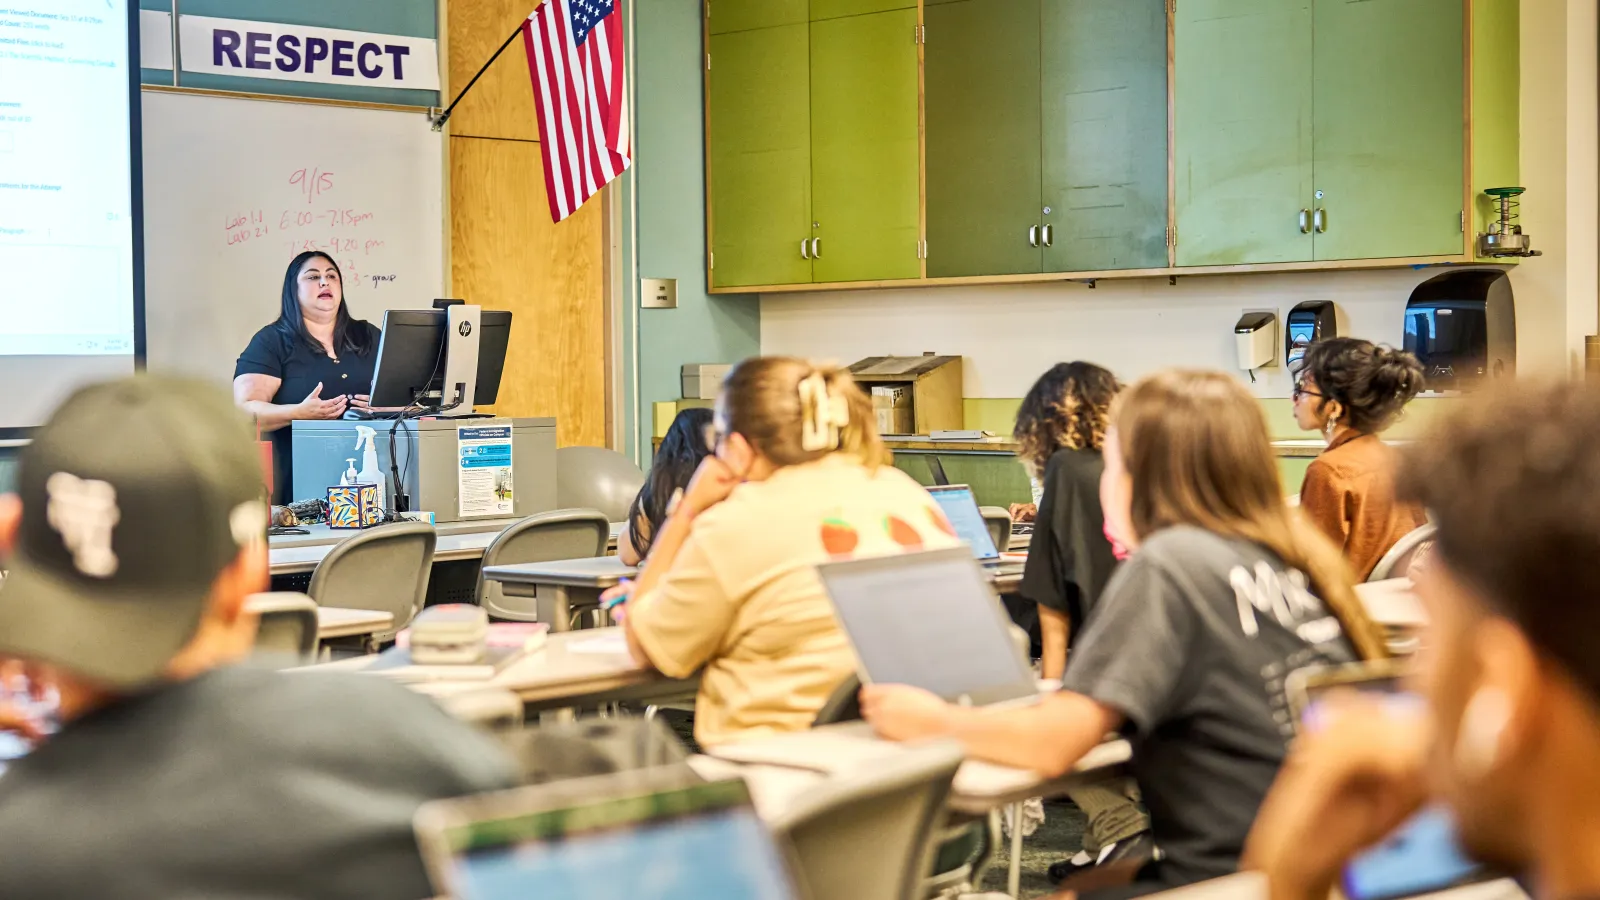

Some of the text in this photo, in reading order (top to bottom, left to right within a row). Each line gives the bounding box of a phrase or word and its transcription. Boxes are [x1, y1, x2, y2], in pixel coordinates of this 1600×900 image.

[213, 28, 410, 80] RESPECT
[288, 167, 334, 204] 9/15
[225, 211, 247, 230] Lab
[227, 231, 251, 246] Lab
[365, 238, 386, 256] pm
[372, 274, 397, 289] group
[459, 321, 472, 337] hp
